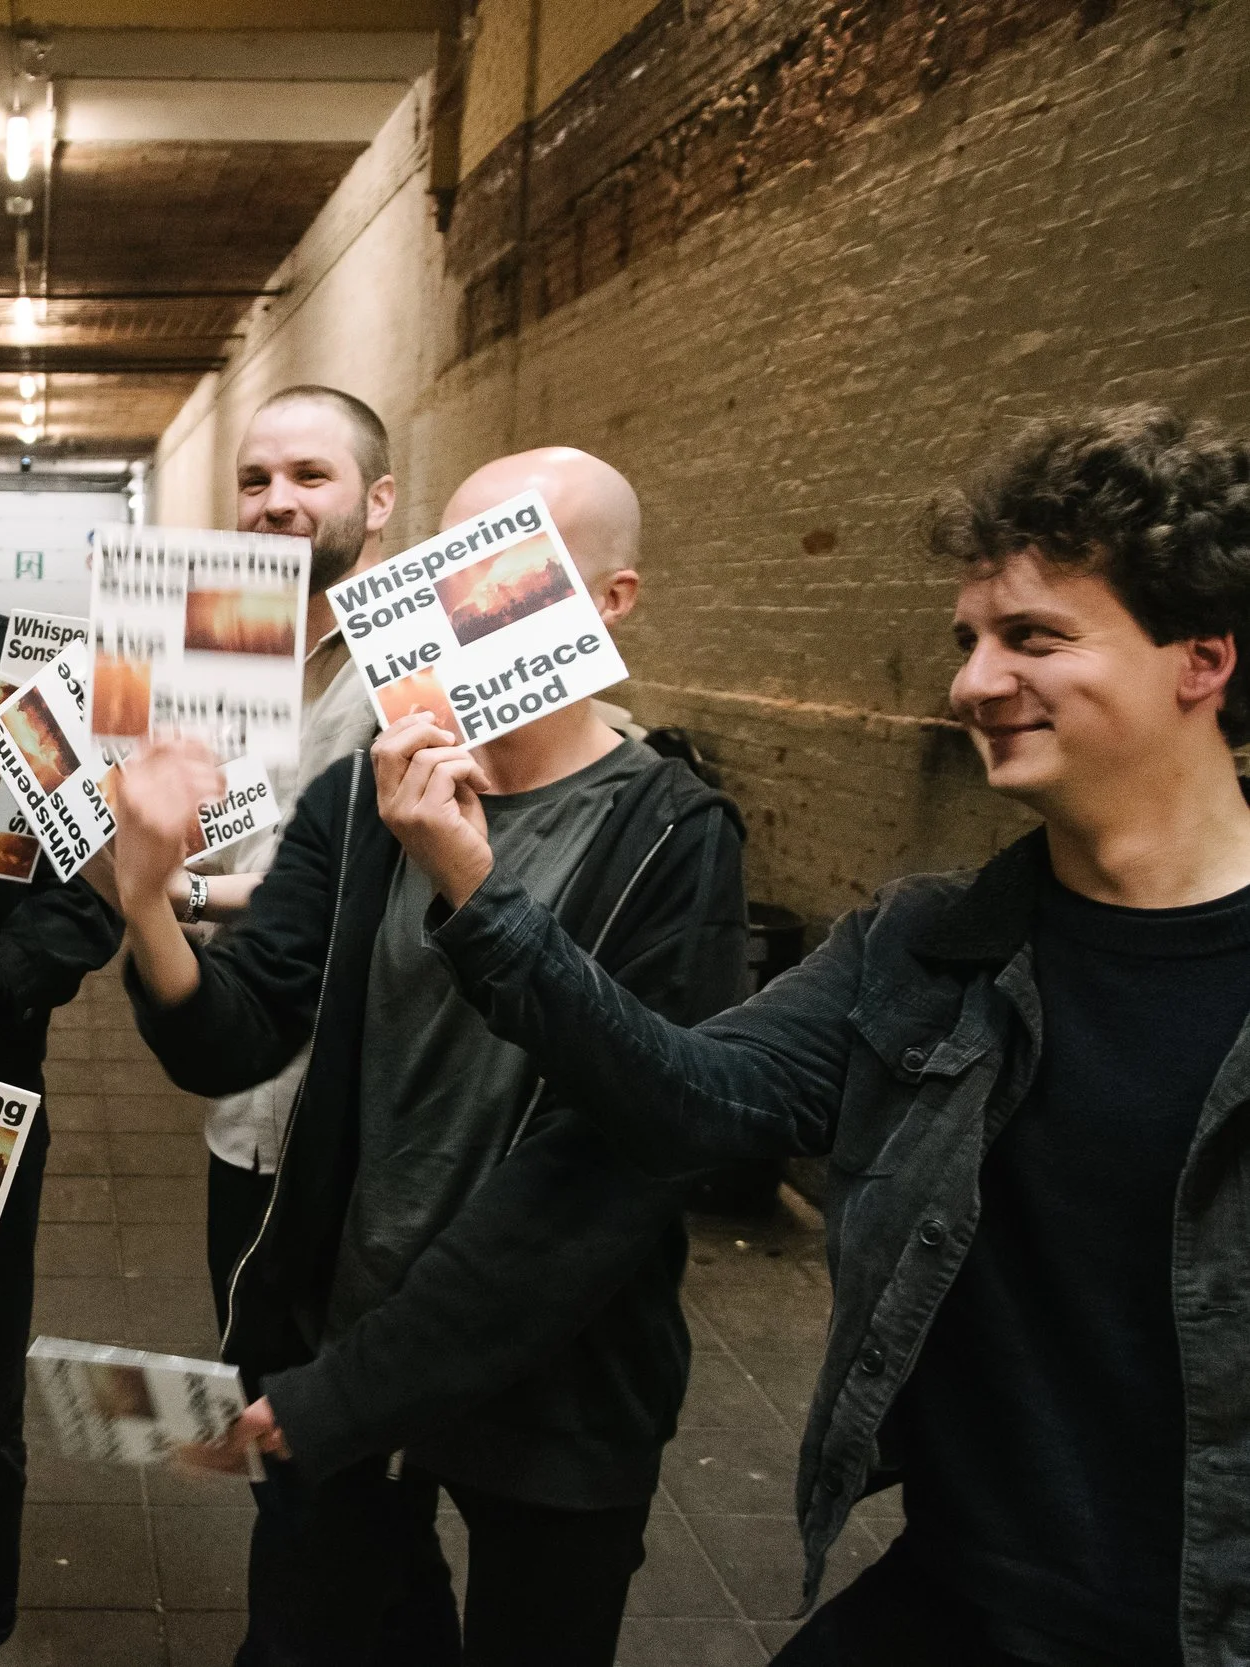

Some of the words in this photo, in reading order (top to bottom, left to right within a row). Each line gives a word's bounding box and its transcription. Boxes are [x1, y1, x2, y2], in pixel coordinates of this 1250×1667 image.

[335, 504, 542, 613] Whispering
[14, 616, 88, 647] Whispe
[347, 587, 436, 639] Sons
[365, 642, 442, 688] Live
[450, 634, 600, 712] Surface
[460, 674, 568, 741] Flood
[51, 792, 90, 860] Sons
[82, 778, 116, 836] Live
[198, 782, 267, 823] Surface
[204, 809, 255, 847] Flood
